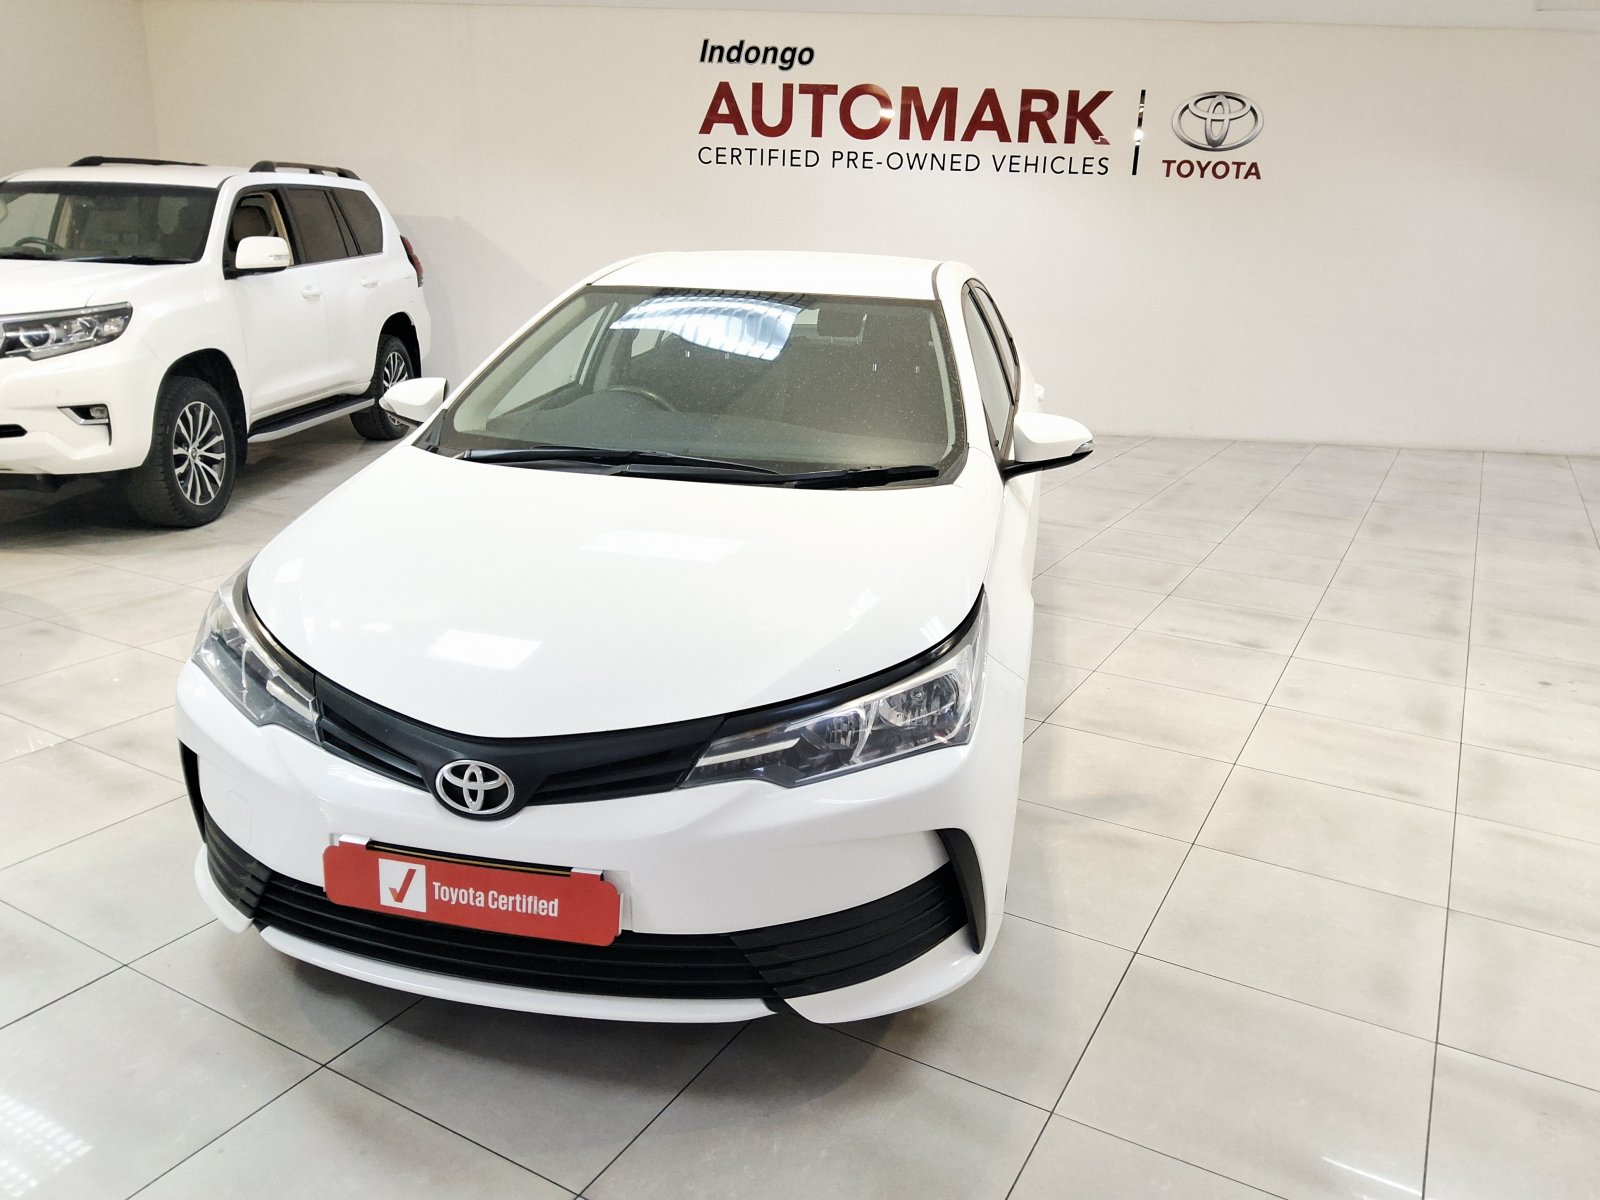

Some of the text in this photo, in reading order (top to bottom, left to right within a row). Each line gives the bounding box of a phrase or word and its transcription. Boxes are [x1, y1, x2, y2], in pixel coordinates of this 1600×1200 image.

[699, 39, 814, 70] Indongo
[698, 81, 1114, 145] AUTOMARK
[698, 146, 1109, 175] CERTIFIED PRE-OWNED VEHICLES
[1163, 160, 1261, 180] TOYOTA
[433, 882, 558, 917] Toyota Certified
